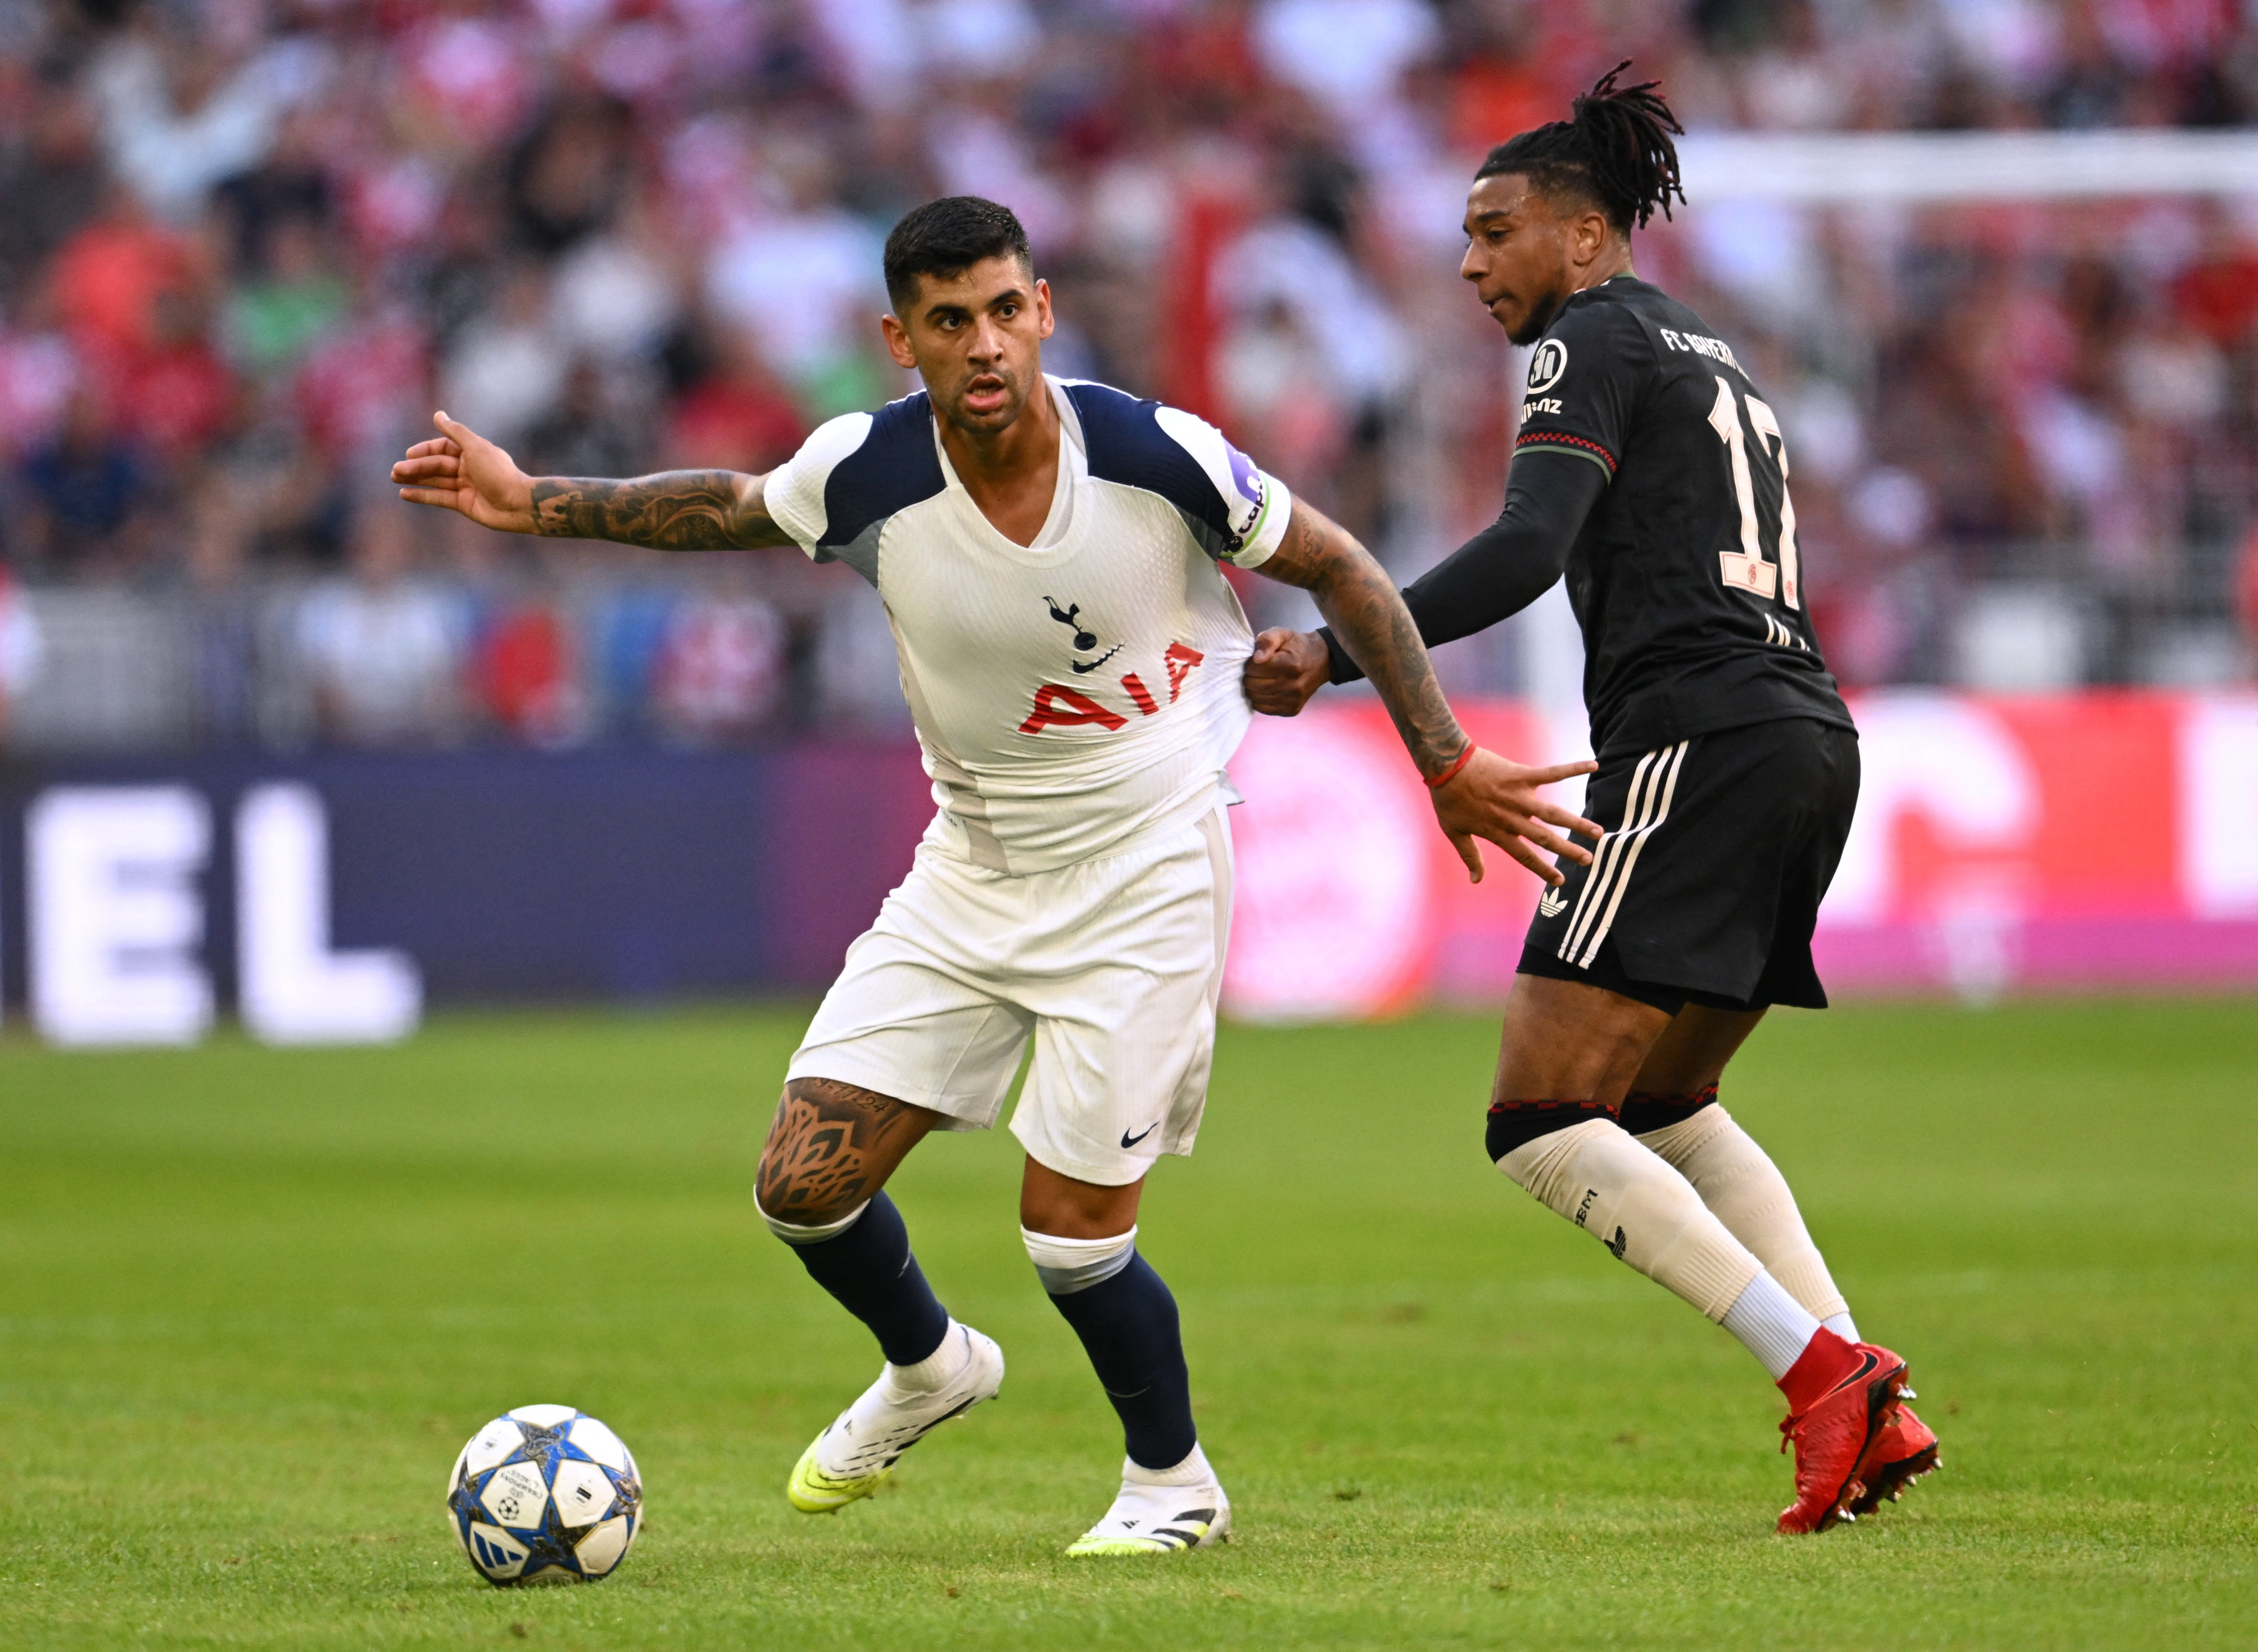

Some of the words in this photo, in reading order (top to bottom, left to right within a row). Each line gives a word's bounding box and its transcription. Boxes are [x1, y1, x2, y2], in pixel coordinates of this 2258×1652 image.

[1660, 329, 1689, 351] FC
[1707, 375, 1800, 610] 17
[1018, 642, 1204, 734] AIA
